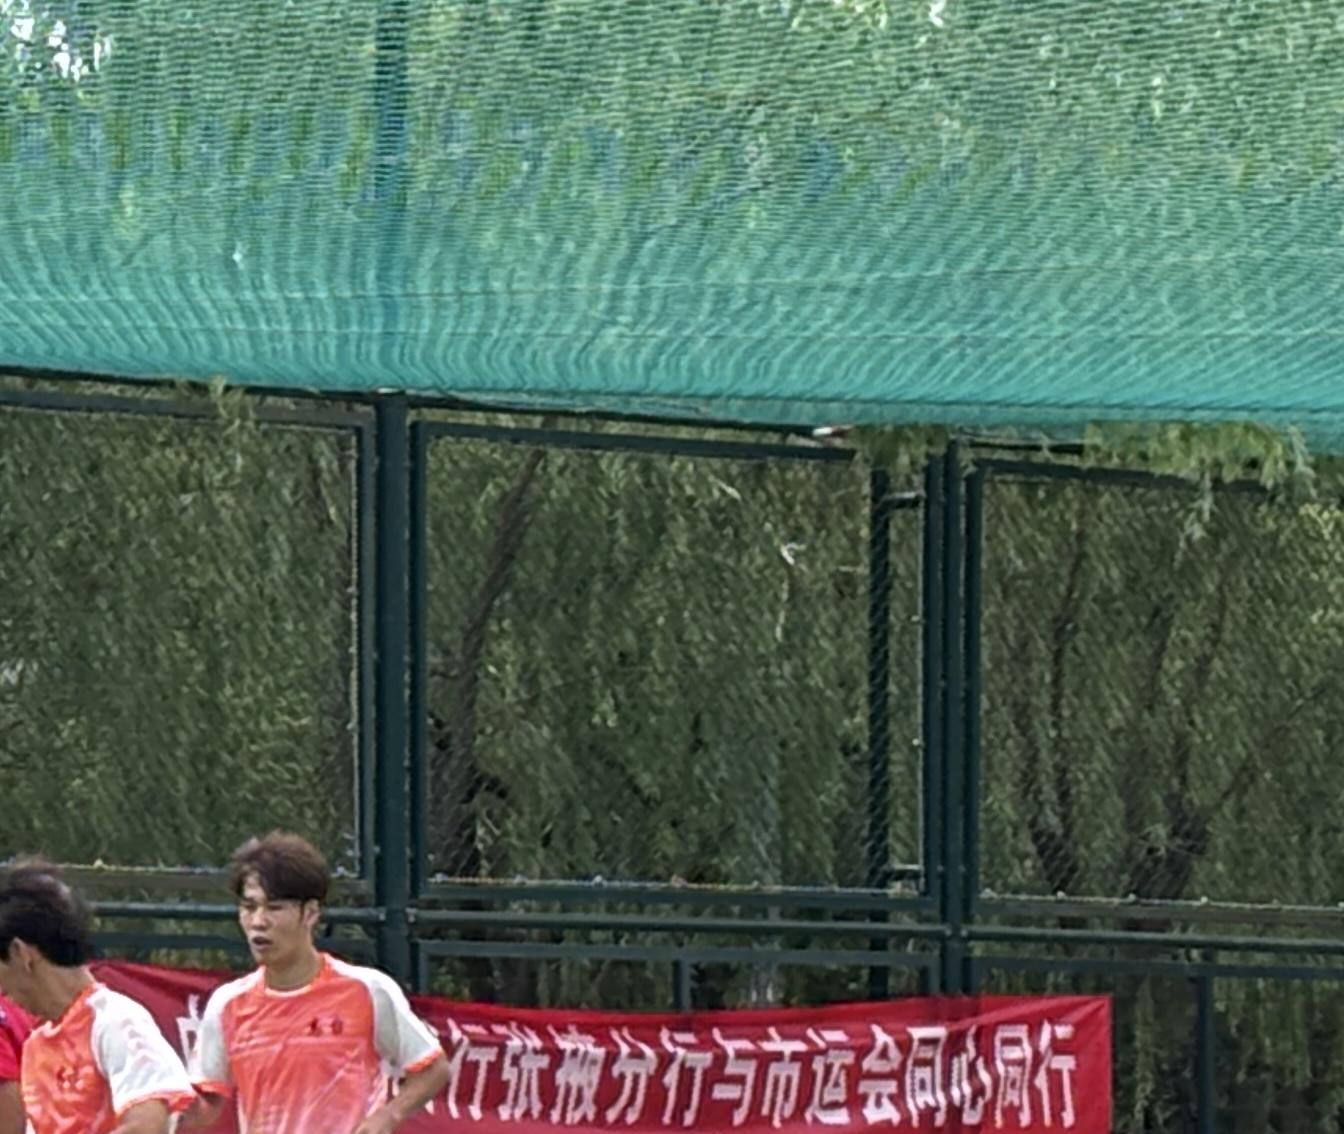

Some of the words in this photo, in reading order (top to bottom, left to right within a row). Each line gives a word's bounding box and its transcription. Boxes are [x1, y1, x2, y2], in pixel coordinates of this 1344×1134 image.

[424, 1017, 1077, 1128] 行张掖分行与市运会同心同行
